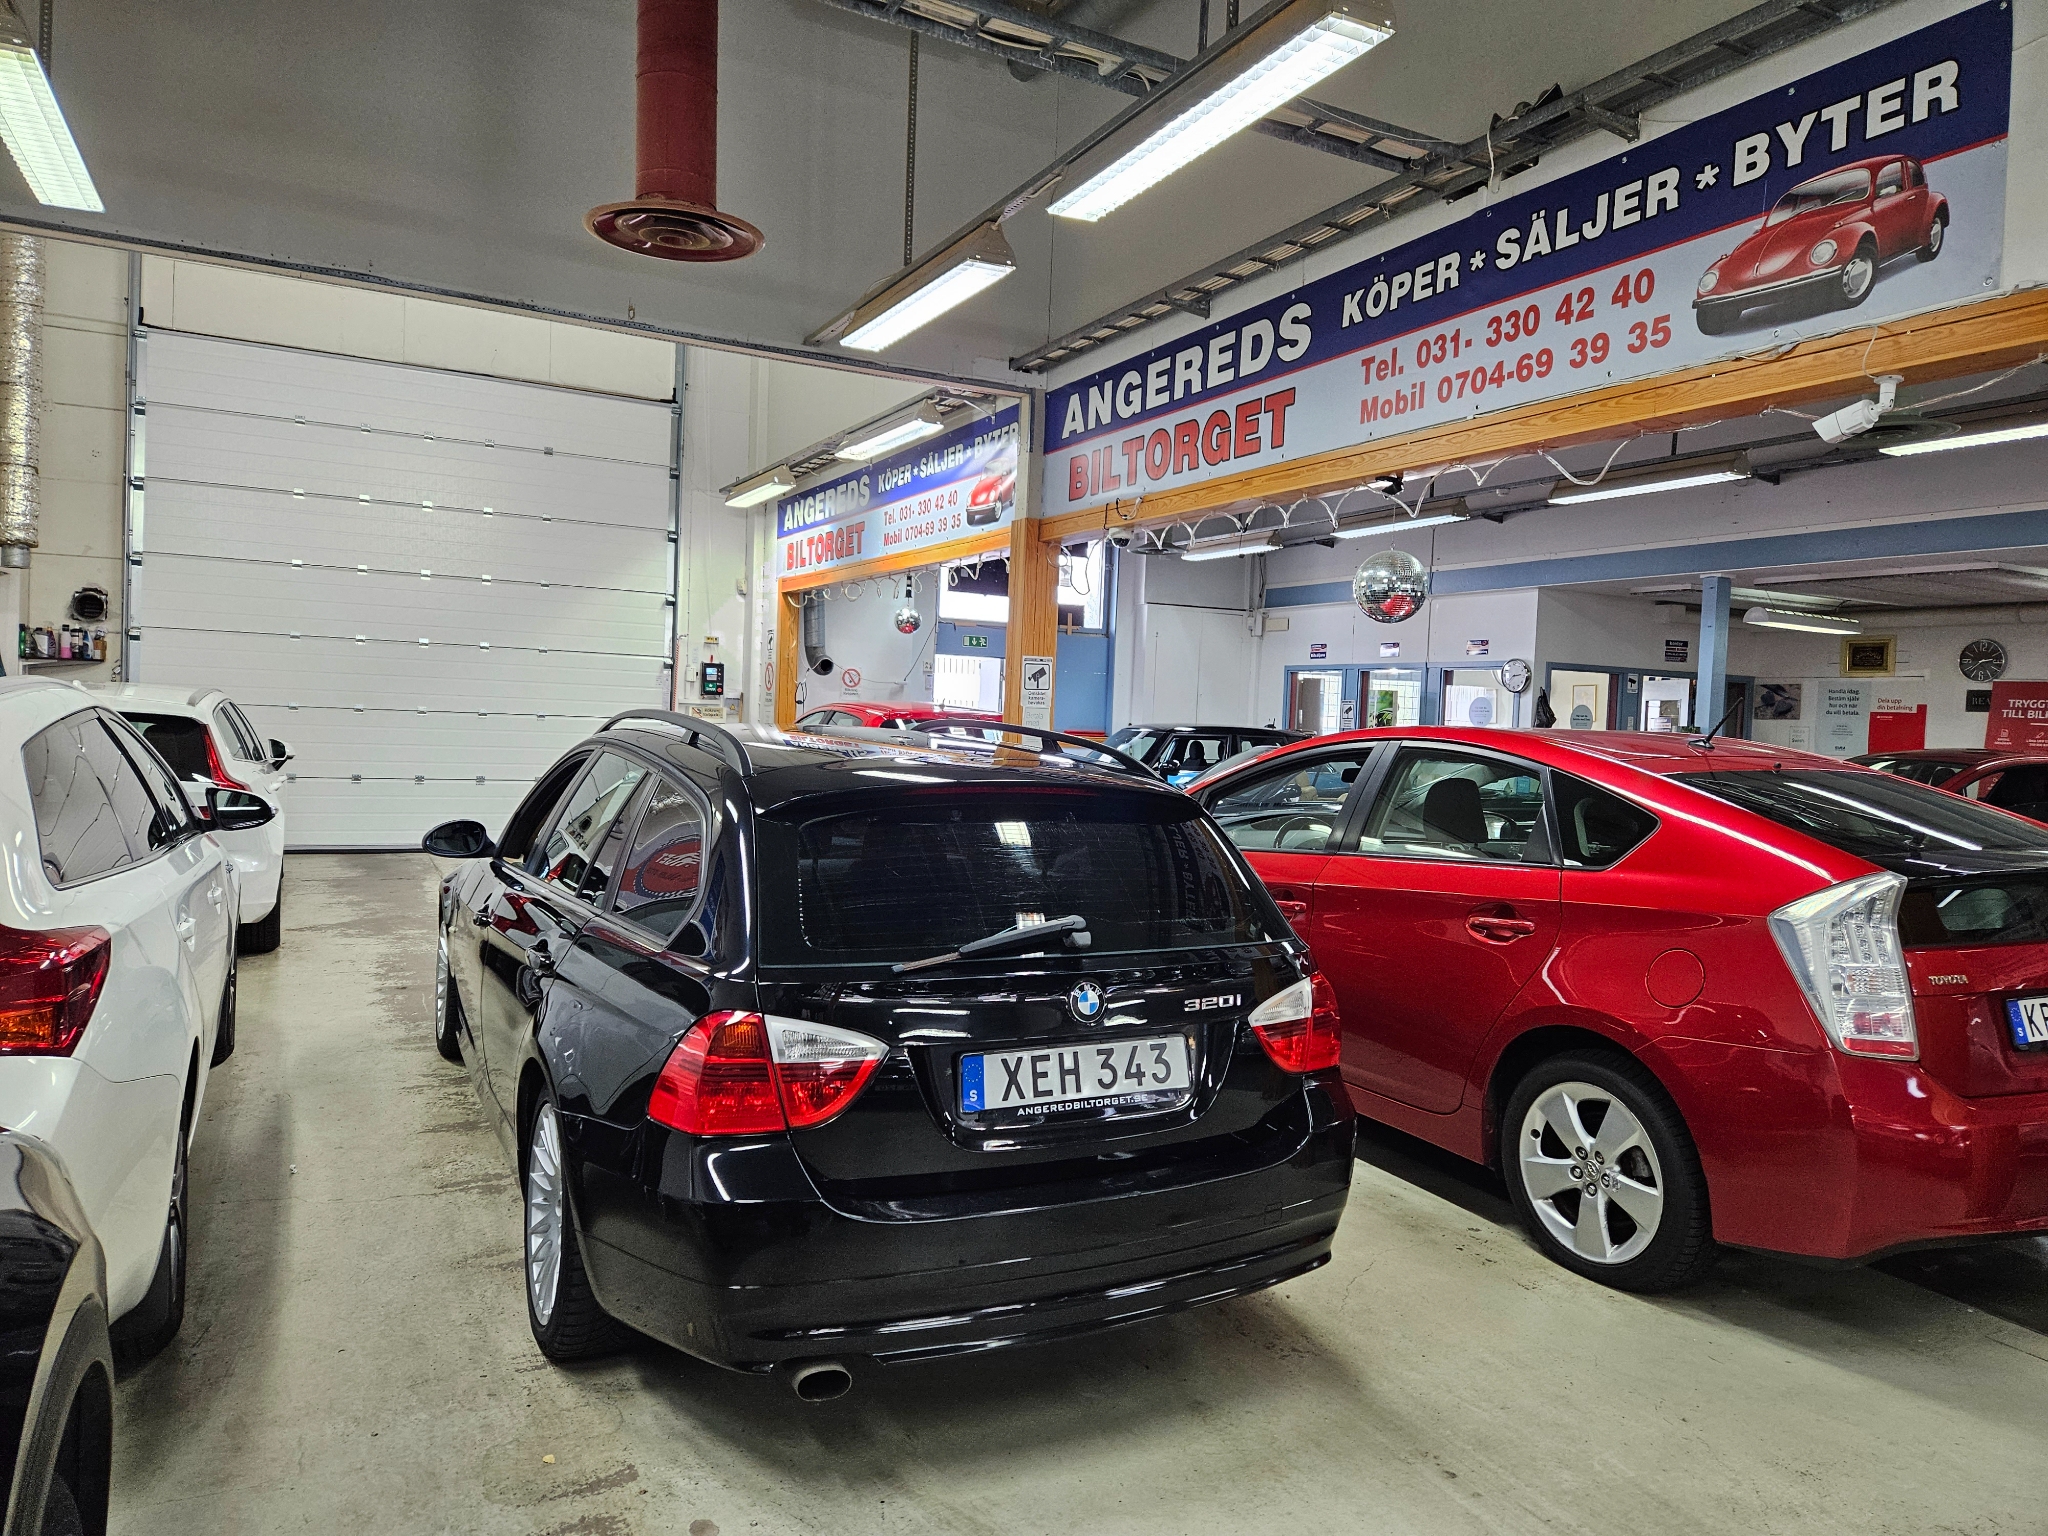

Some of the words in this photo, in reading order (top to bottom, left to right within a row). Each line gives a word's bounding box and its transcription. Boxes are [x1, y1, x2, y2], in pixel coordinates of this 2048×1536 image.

[1061, 302, 1312, 440] ANGEREDS
[1340, 251, 1462, 329] KÖPER
[1495, 167, 1681, 270] SÄLJER
[1733, 60, 1959, 187] BYTER
[1361, 347, 1404, 385] Tel.
[1416, 328, 1473, 369] 031-
[1485, 303, 1541, 348] 330
[1555, 287, 1595, 326] 42
[1611, 268, 1656, 309] 40
[1360, 380, 1425, 424] Mobil
[1437, 348, 1554, 403] 0704-69
[1569, 332, 1611, 369] 39
[1627, 314, 1672, 354] 35
[1068, 387, 1296, 502] BILTORGET
[783, 475, 871, 533] ANGEREDS
[878, 463, 911, 493] KÖPER
[920, 443, 964, 478] SÄLJER
[974, 422, 1019, 460] BYTER
[883, 527, 903, 547] Mobil
[905, 521, 935, 541] 0704-69
[938, 517, 948, 533] 39
[951, 513, 961, 530] 35
[884, 509, 897, 526] Tel.
[918, 498, 932, 515] 330
[934, 494, 945, 511] 42
[947, 490, 958, 508] 40
[787, 521, 865, 571] BILTORGET
[2002, 709, 2025, 718] TILL
[1928, 974, 1969, 986] TOYOTA
[969, 1089, 978, 1101] S
[1001, 1052, 1082, 1102] XEH
[1097, 1043, 1171, 1090] 343
[1017, 1094, 1149, 1117] ANGEREDBILTORGET.SE
